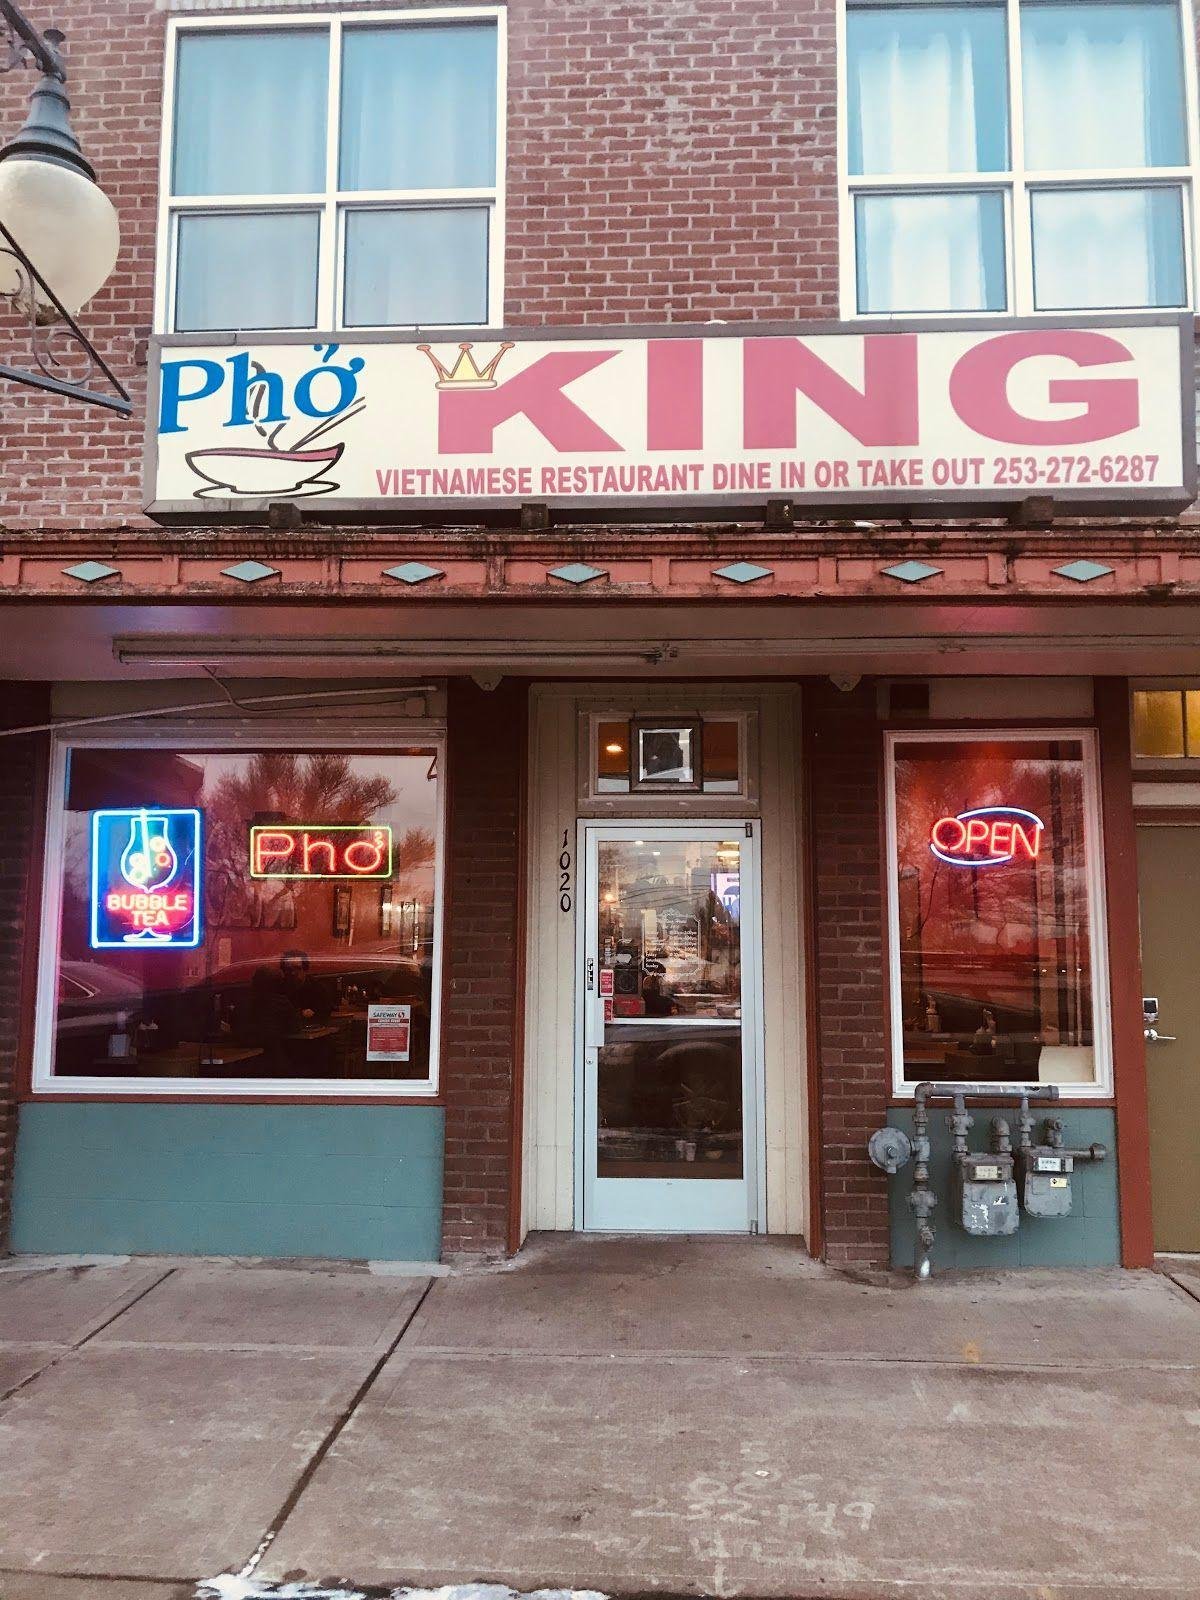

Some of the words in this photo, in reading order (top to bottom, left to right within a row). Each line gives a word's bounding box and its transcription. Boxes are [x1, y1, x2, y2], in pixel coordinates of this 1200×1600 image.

[436, 330, 1139, 454] KING
[375, 467, 532, 496] VIETNAMESE
[541, 464, 705, 494] RESTAURANT
[712, 462, 771, 490] DINE
[780, 461, 806, 489] IN
[814, 460, 850, 488] OR
[857, 458, 924, 487] TAKE
[932, 457, 986, 486] OUT
[992, 454, 1160, 485] 253-272-6287
[931, 816, 1041, 859] OPEN
[558, 828, 573, 914] 1020
[105, 893, 189, 912] BUBBLE
[130, 910, 170, 927] TEA
